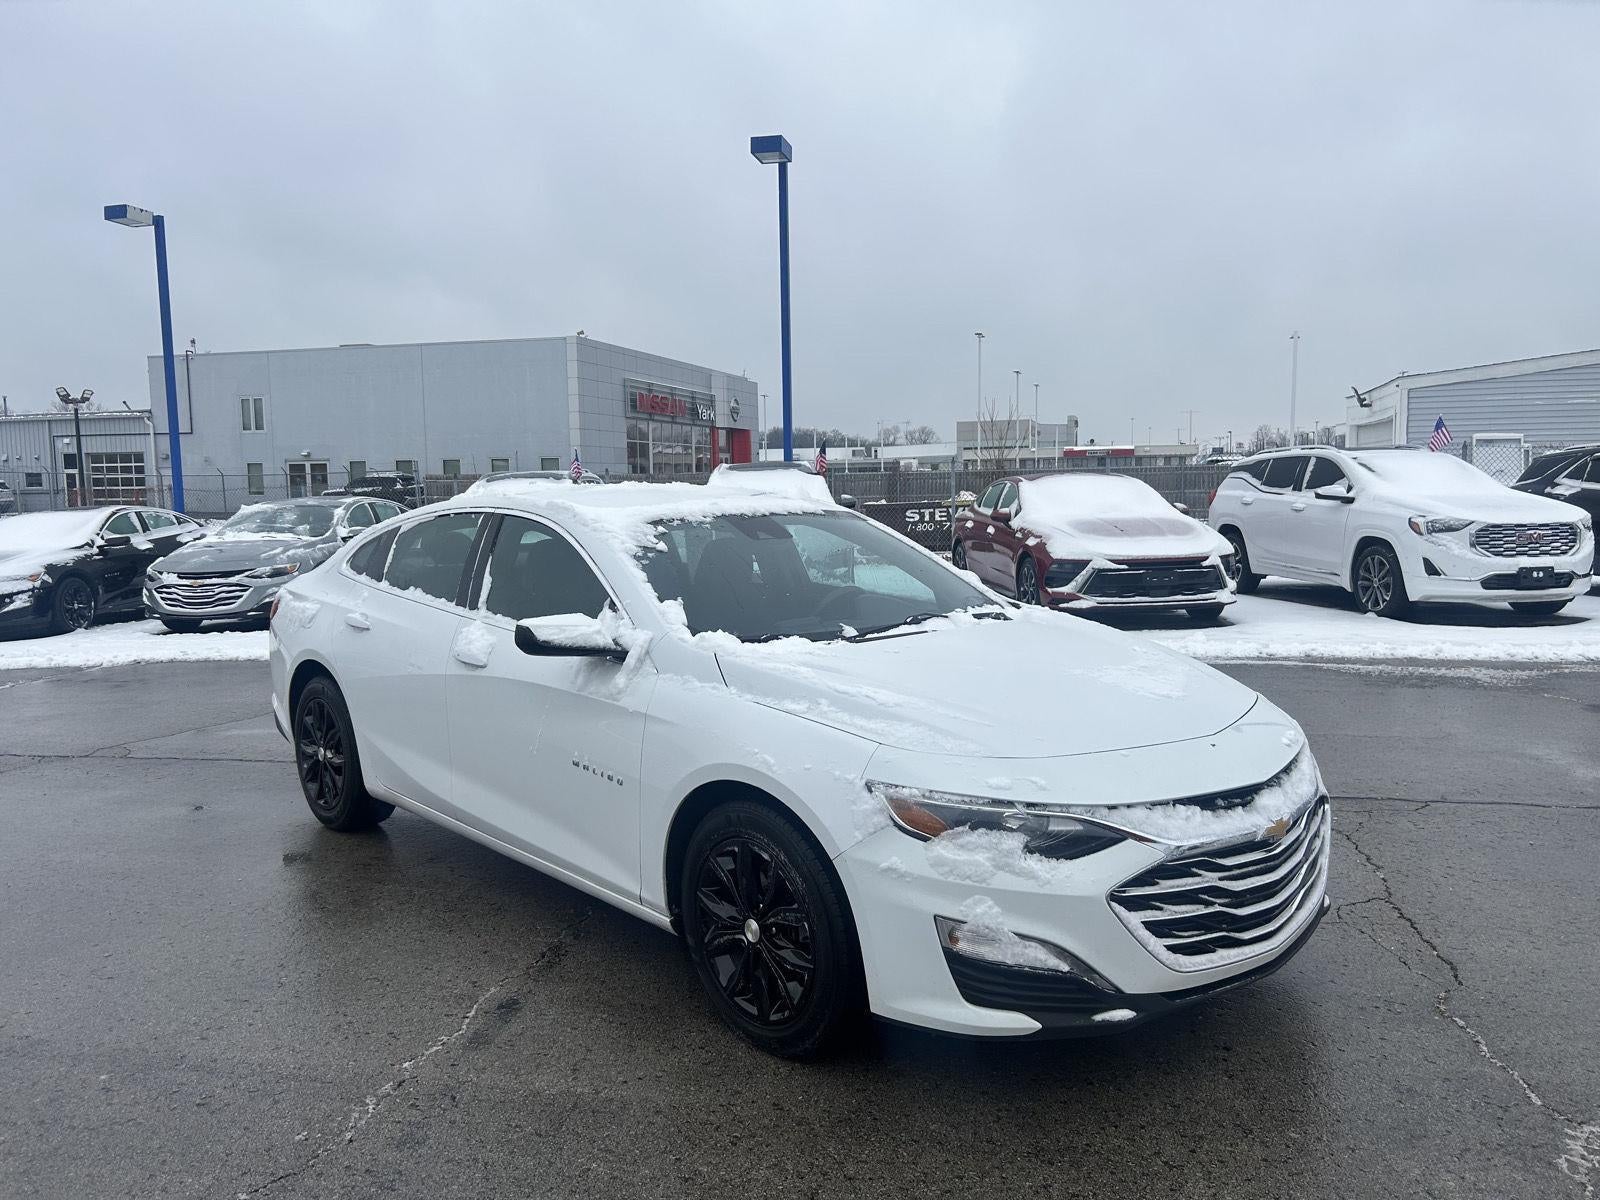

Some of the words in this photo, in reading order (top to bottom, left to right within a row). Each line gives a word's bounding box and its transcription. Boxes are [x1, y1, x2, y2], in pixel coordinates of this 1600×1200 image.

[636, 391, 688, 417] NISSAN
[696, 403, 715, 421] Yark
[1516, 531, 1553, 544] GMC
[572, 760, 624, 786] MALIBU
